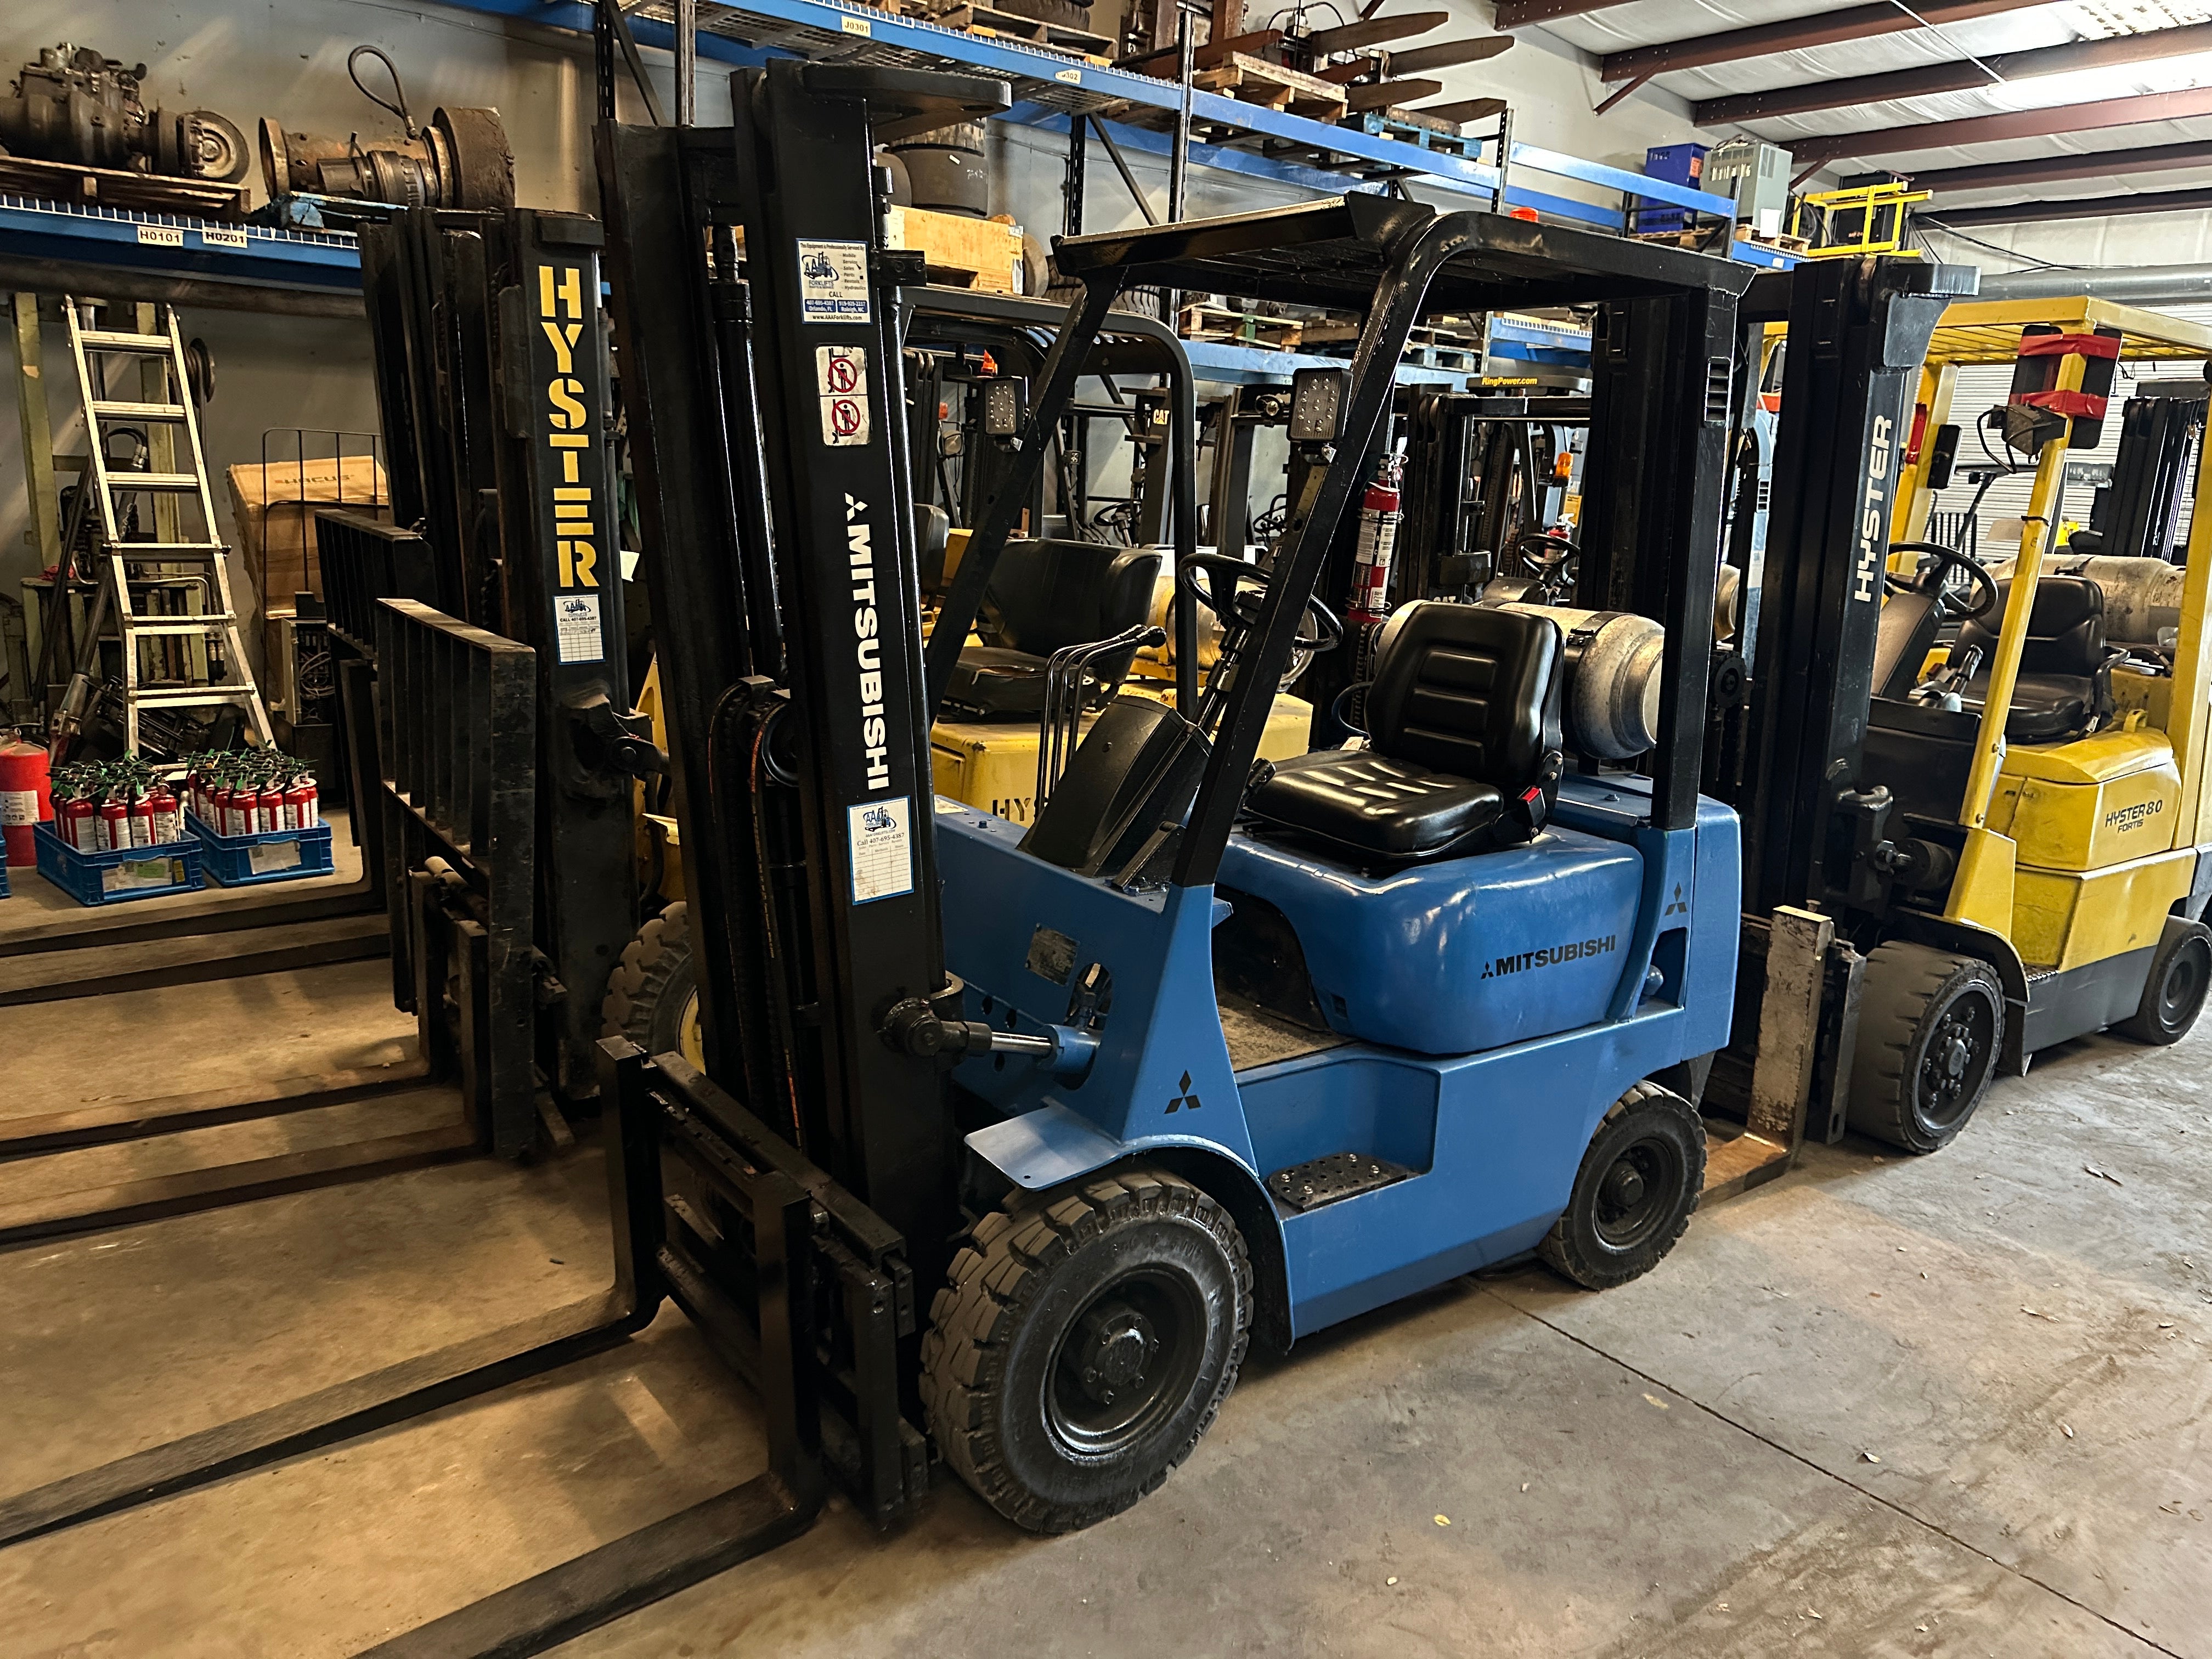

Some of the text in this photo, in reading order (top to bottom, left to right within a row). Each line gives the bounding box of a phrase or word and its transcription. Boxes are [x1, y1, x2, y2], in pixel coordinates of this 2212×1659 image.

[845, 21, 868, 32] J0301
[140, 230, 180, 242] H0101
[206, 232, 244, 243] H0201
[1482, 377, 1537, 386] RingPower.com
[1153, 409, 1169, 425] CAT
[539, 266, 599, 587] HYSTER
[1854, 415, 1892, 602] HYSTER
[847, 524, 889, 790] MITSUBISHI
[2105, 799, 2163, 828] HYSTER 80
[2118, 819, 2144, 833] FORTIS
[870, 833, 905, 844] 407-695-4387
[1496, 935, 1616, 977] MITSUBISHI
